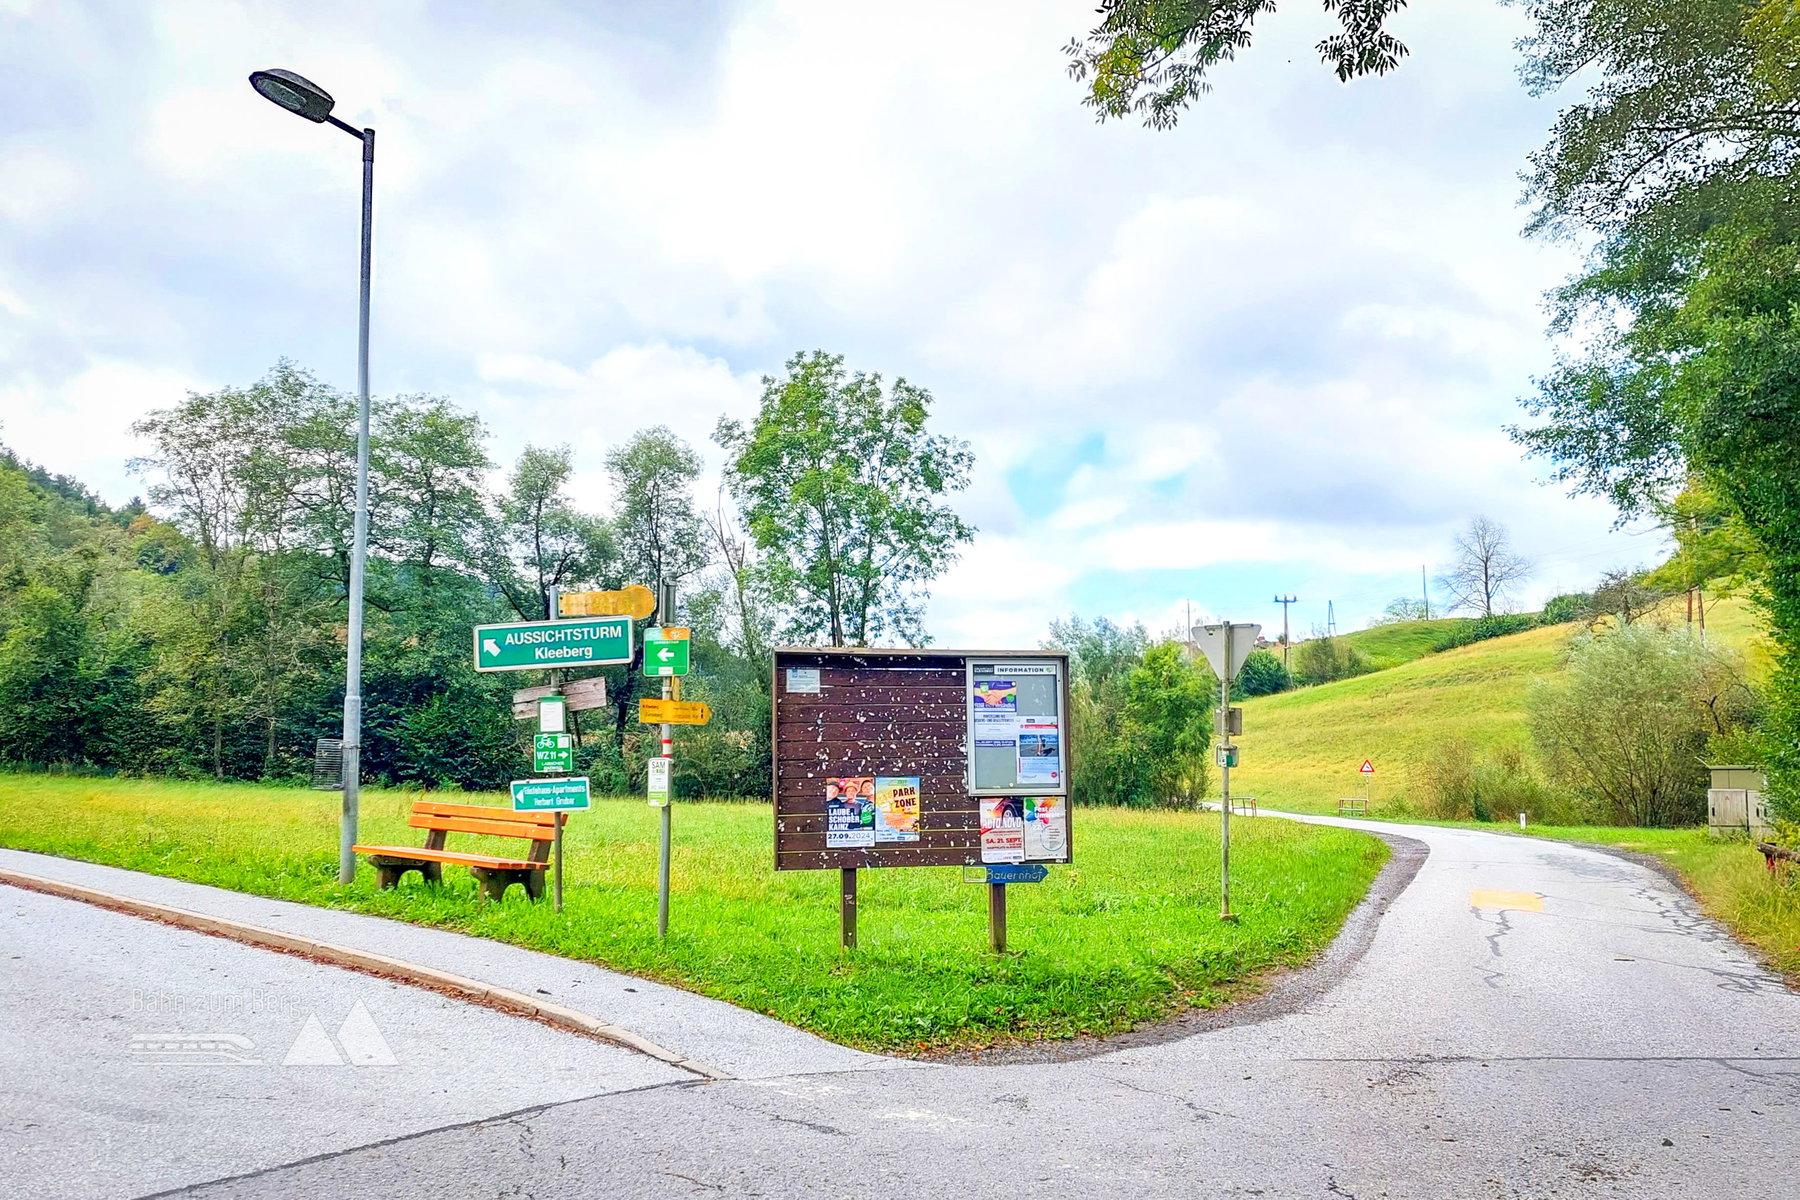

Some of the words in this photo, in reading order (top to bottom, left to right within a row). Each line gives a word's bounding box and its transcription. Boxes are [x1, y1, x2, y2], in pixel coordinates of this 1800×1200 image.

[505, 626, 622, 645] AUSSICHTSTURM
[535, 646, 593, 660] Kleeberg
[537, 751, 549, 760] WZ
[550, 751, 557, 760] 11
[651, 761, 666, 769] SAM
[893, 787, 916, 797] PARK
[894, 798, 917, 808] ZONE
[828, 823, 849, 831] KAINZ
[986, 867, 1043, 881] Bauernhof
